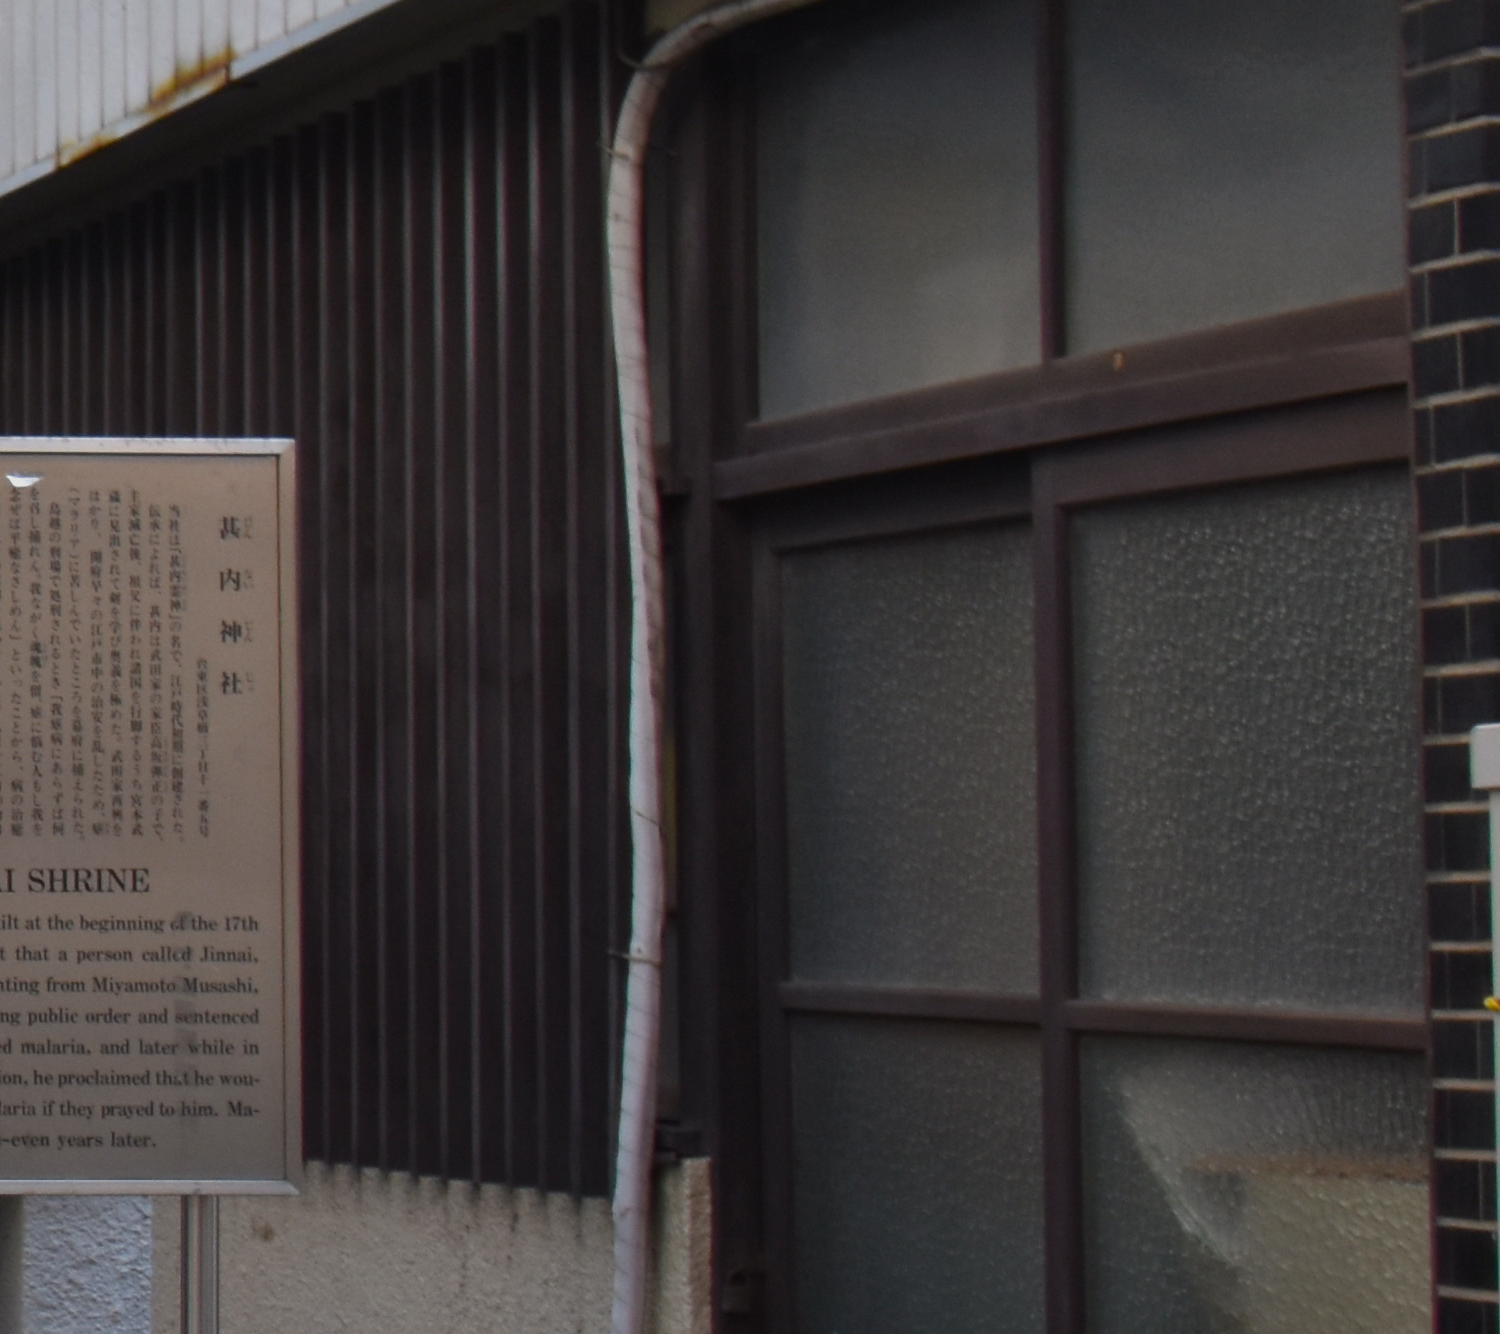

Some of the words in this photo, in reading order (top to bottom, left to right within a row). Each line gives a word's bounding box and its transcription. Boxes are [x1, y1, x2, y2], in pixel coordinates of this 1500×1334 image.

[218, 515, 244, 695] 甚内神社
[28, 867, 150, 893] SHRINE
[25, 916, 41, 930] at
[48, 915, 74, 931] the
[80, 915, 166, 933] beginning
[170, 916, 190, 931] of
[191, 916, 218, 932] the
[225, 916, 259, 932] 17th
[15, 945, 49, 961] that
[58, 950, 68, 962] a
[77, 950, 133, 964] person
[142, 946, 193, 962] called
[46, 976, 86, 992] from
[92, 976, 177, 996] Miyamoto
[28, 1007, 78, 1027] public
[85, 1007, 131, 1024] order
[138, 1008, 169, 1024] and
[175, 1008, 260, 1024] sentenced
[100, 1038, 130, 1055] and
[139, 1038, 179, 1055] later
[188, 1039, 235, 1055] while
[243, 1039, 260, 1055] in
[33, 1069, 54, 1085] he
[58, 1069, 151, 1087] proclaimed
[155, 1070, 190, 1086] that
[194, 1070, 215, 1086] he
[219, 1074, 260, 1086] wou-
[42, 1100, 55, 1116] if
[59, 1100, 94, 1120] they
[101, 1100, 154, 1119] prayed
[159, 1102, 176, 1117] to
[181, 1101, 219, 1117] him.
[227, 1100, 260, 1117] Ma-
[57, 1135, 103, 1150] years
[111, 1131, 157, 1148] later.
